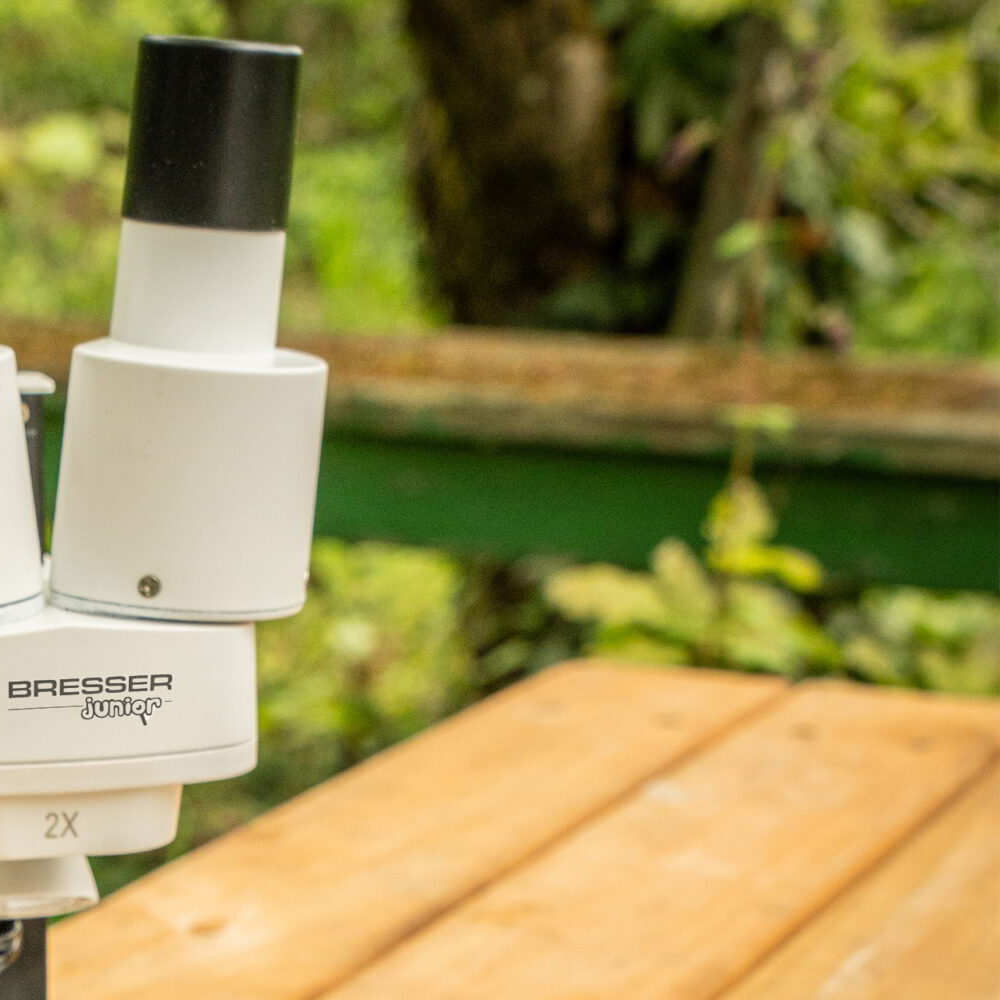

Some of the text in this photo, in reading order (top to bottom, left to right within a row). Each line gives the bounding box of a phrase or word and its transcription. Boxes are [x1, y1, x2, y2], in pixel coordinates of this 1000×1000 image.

[8, 674, 173, 698] BRESSER
[81, 697, 161, 726] junior
[44, 811, 79, 839] 2X
